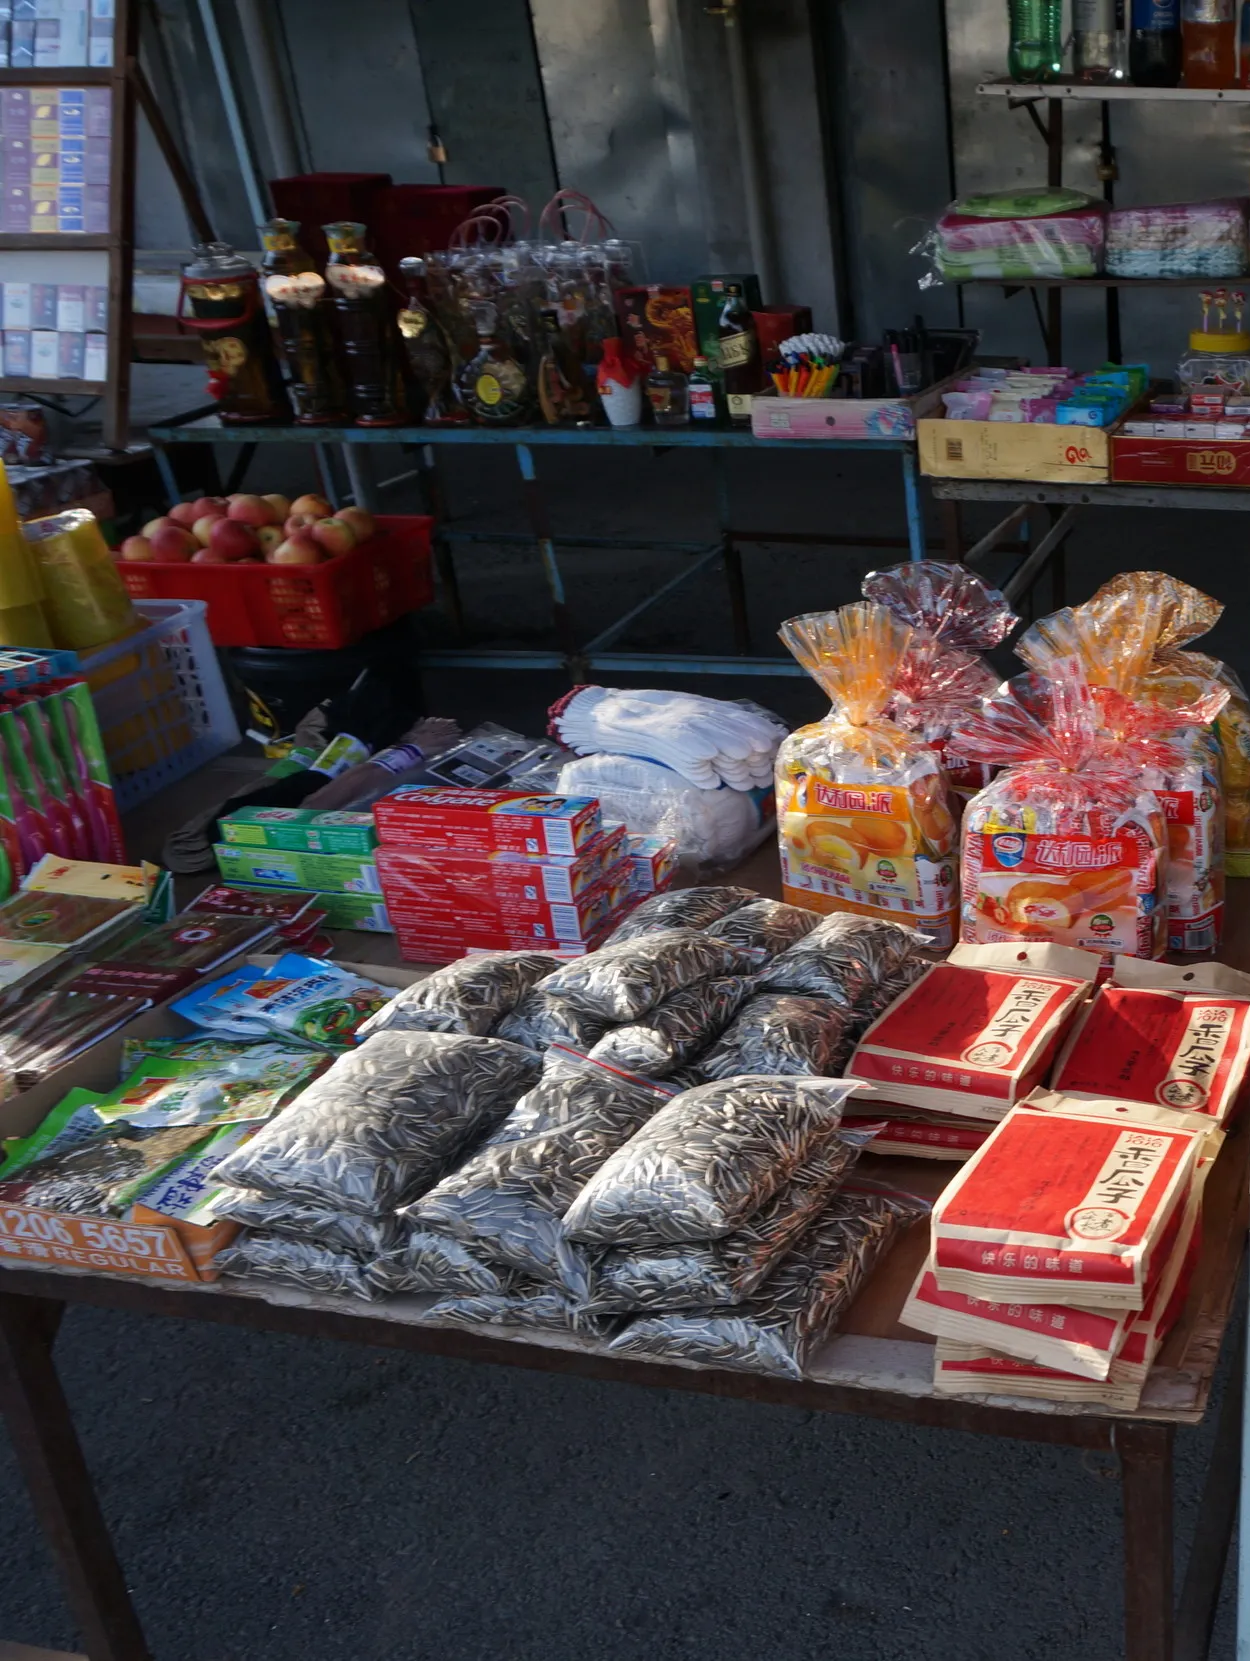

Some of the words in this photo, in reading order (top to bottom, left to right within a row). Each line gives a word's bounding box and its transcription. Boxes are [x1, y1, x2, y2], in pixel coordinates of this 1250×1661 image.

[394, 792, 496, 806] Colgate
[991, 989, 1048, 1038] 香瓜子
[1199, 1009, 1228, 1023] 洽洽
[1177, 1023, 1228, 1077] 香瓜子
[891, 1064, 973, 1087] 快乐的味道
[1126, 1134, 1165, 1149] 洽洽
[1096, 1146, 1161, 1204] 香瓜子
[80, 1222, 168, 1258] 5657
[52, 1245, 188, 1278] REGULAR
[981, 1250, 1084, 1274] 快乐的味道
